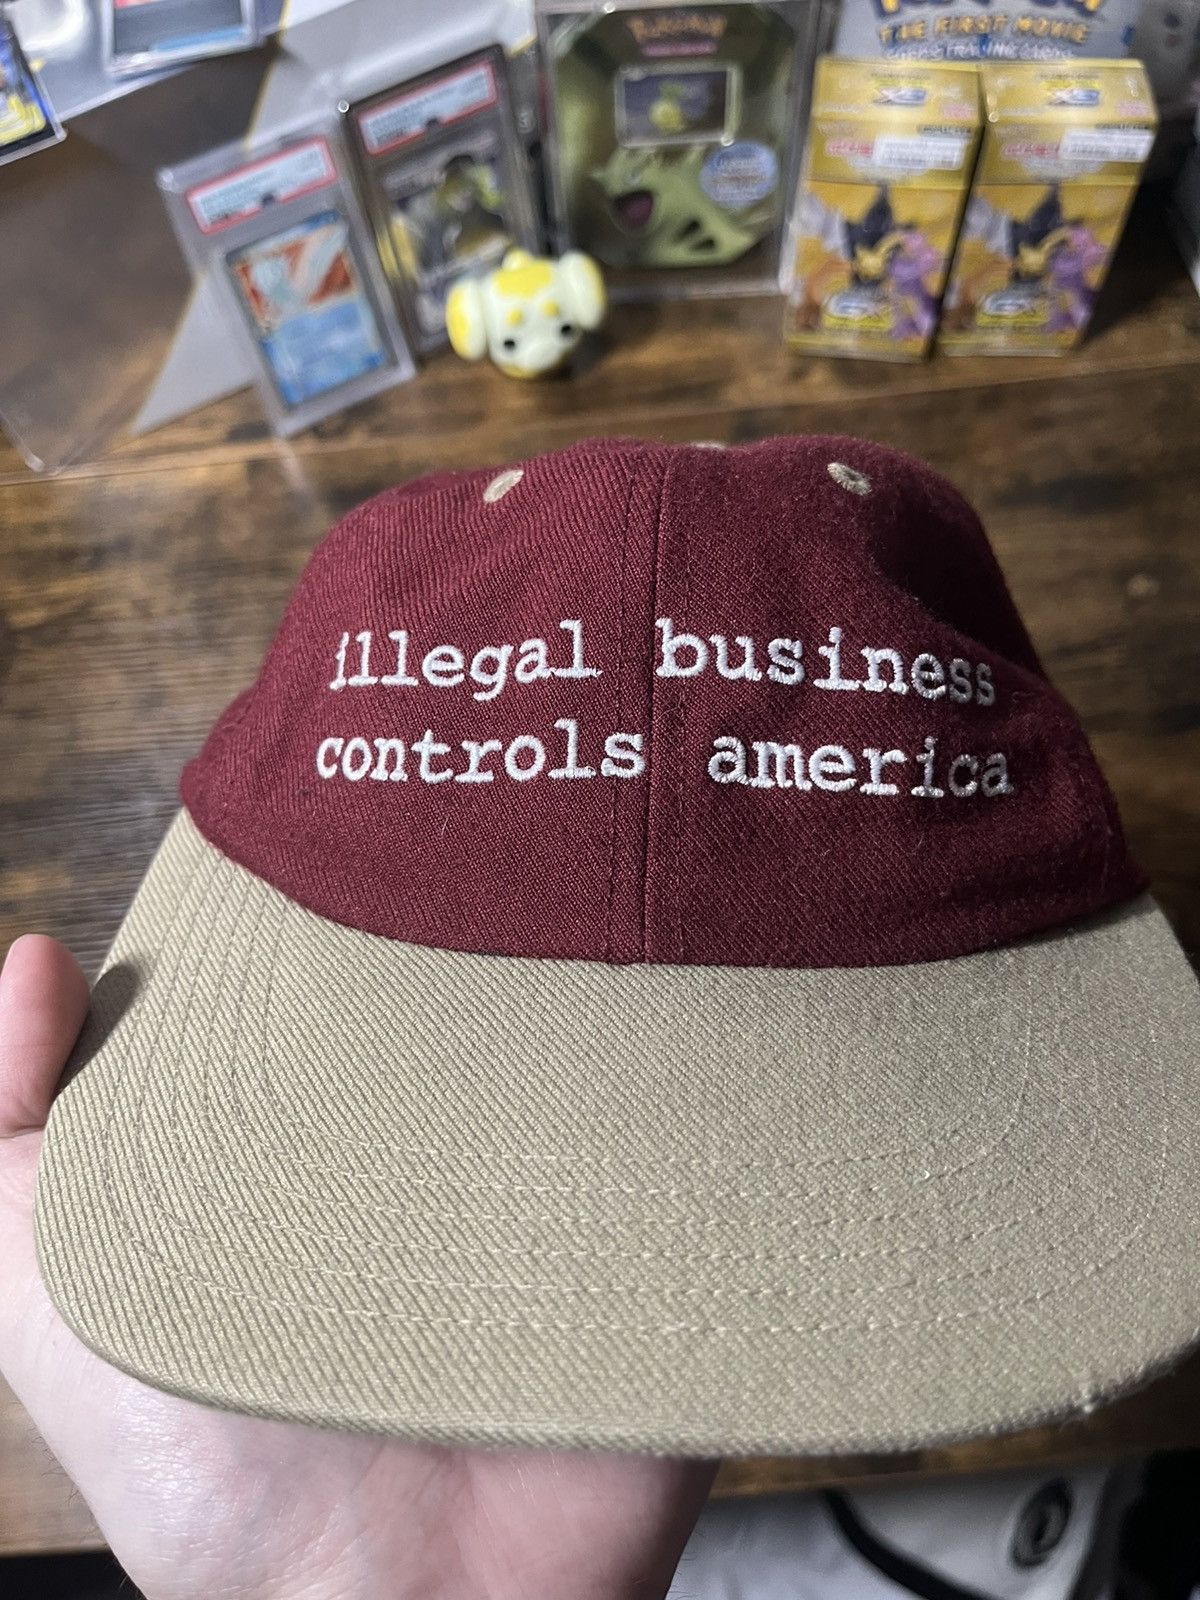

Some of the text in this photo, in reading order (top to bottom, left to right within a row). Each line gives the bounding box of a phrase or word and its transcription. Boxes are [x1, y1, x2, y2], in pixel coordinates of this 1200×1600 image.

[935, 15, 1006, 35] FIRST
[1013, 16, 1088, 44] MOVIE
[329, 618, 996, 706] illegal business
[315, 718, 1013, 798] controls america
